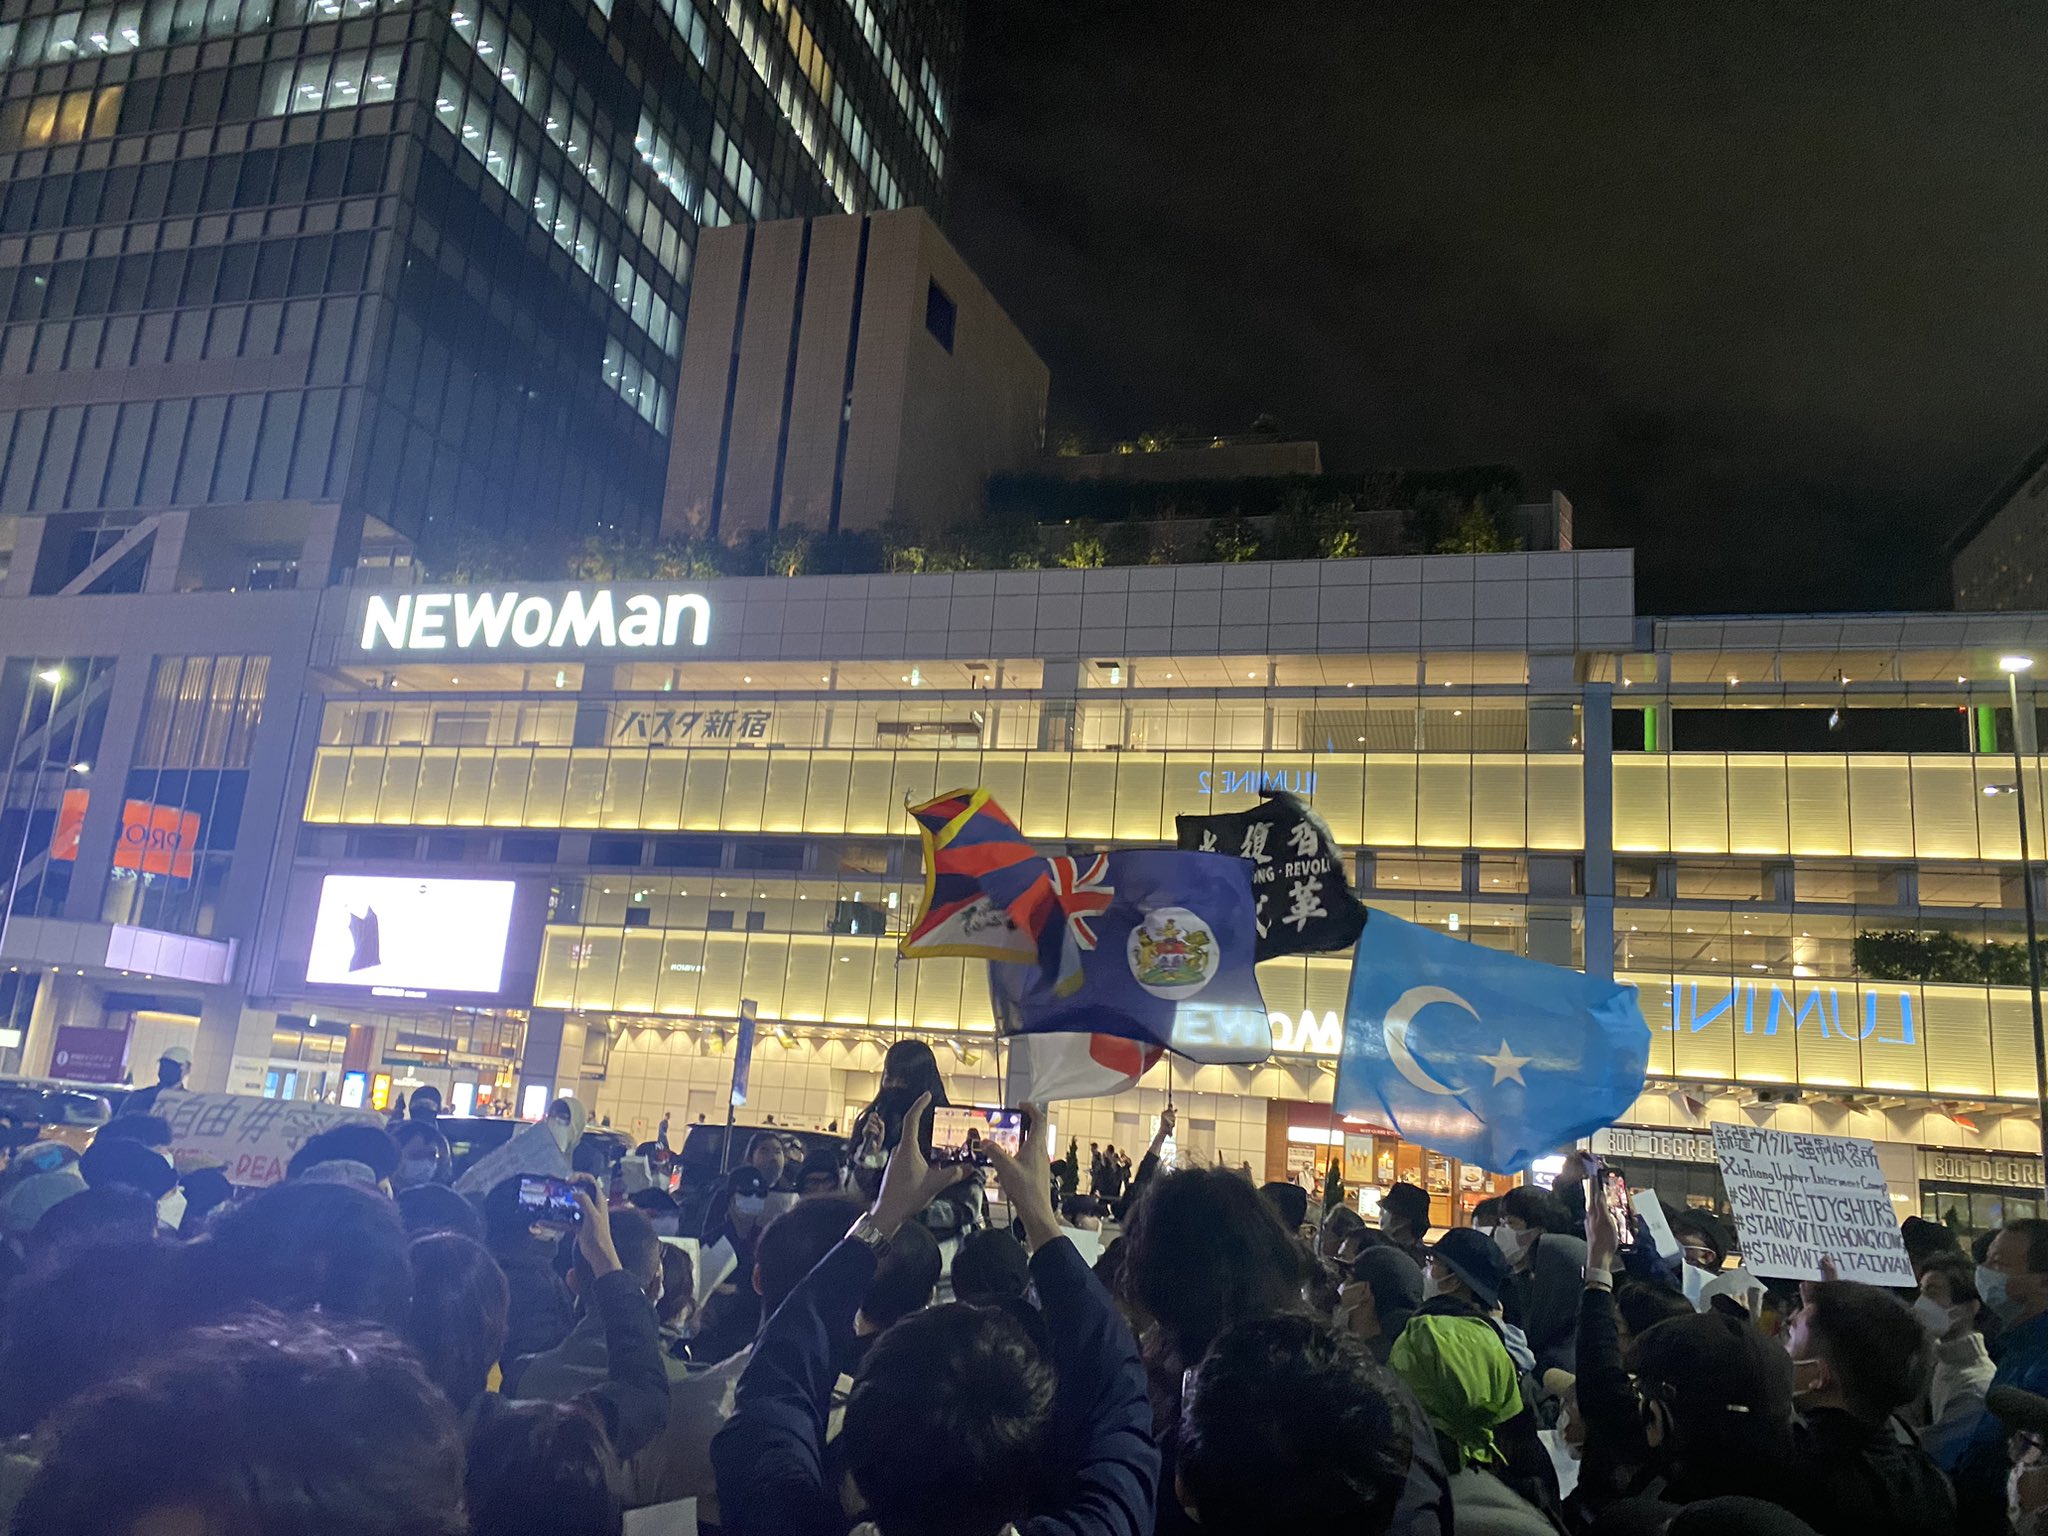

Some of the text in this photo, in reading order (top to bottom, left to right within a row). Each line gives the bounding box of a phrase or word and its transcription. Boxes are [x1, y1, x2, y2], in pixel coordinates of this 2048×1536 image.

[617, 709, 772, 739] バスタ新宿
